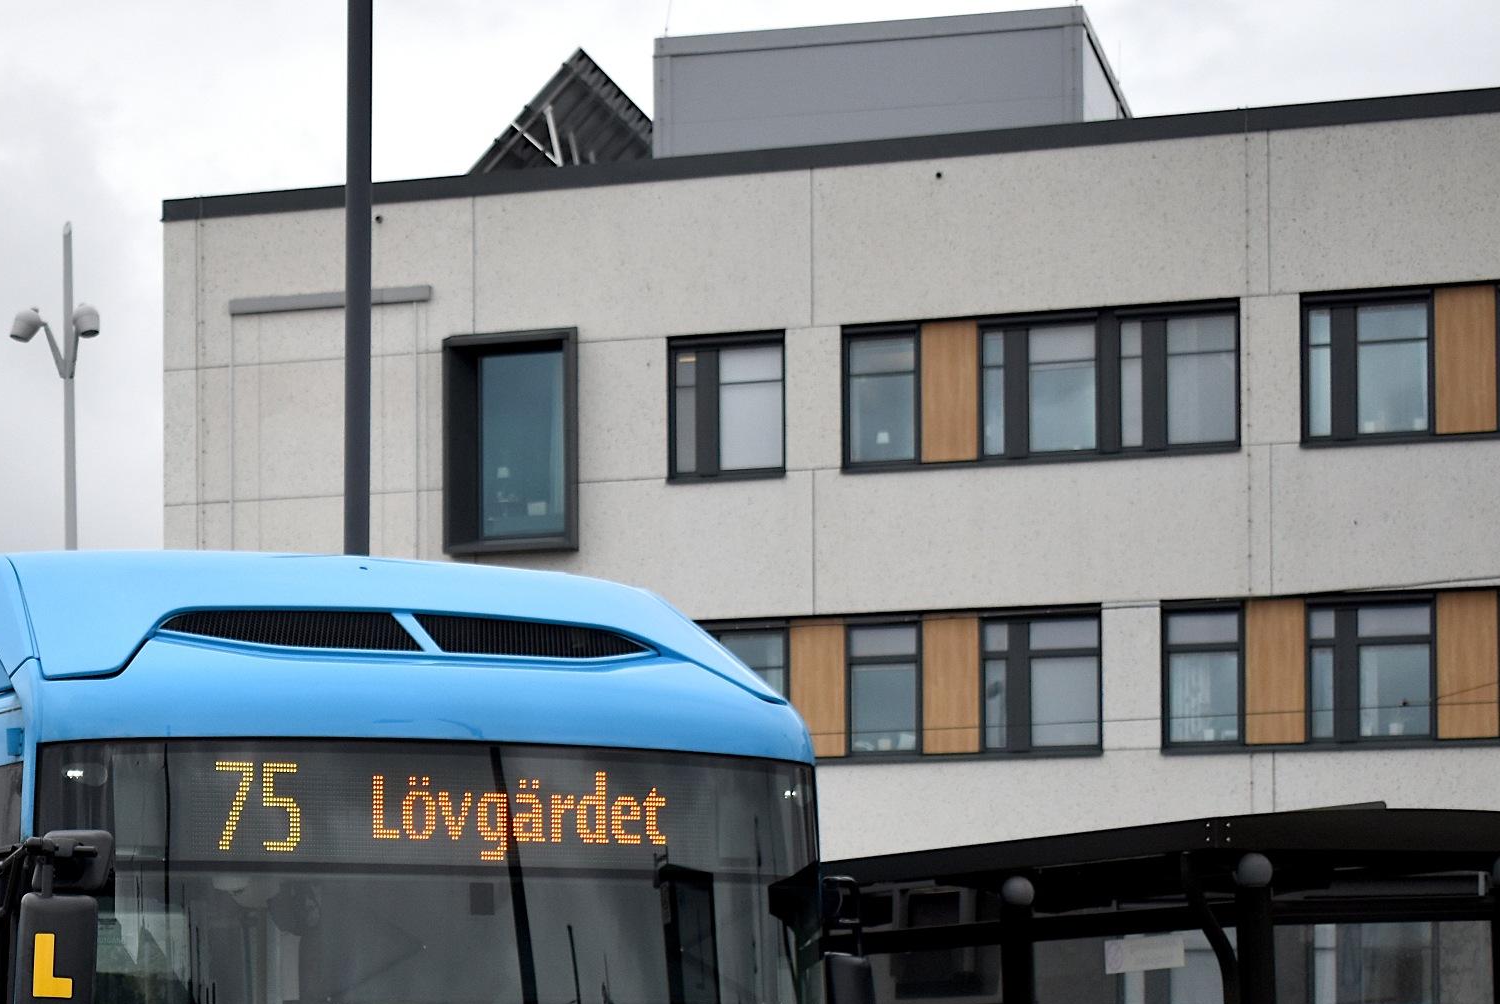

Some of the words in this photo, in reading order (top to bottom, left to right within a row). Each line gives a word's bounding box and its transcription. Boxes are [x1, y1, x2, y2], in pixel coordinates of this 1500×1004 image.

[215, 761, 301, 852] 75
[372, 771, 667, 861] Lövgärdet
[32, 933, 73, 999] L
